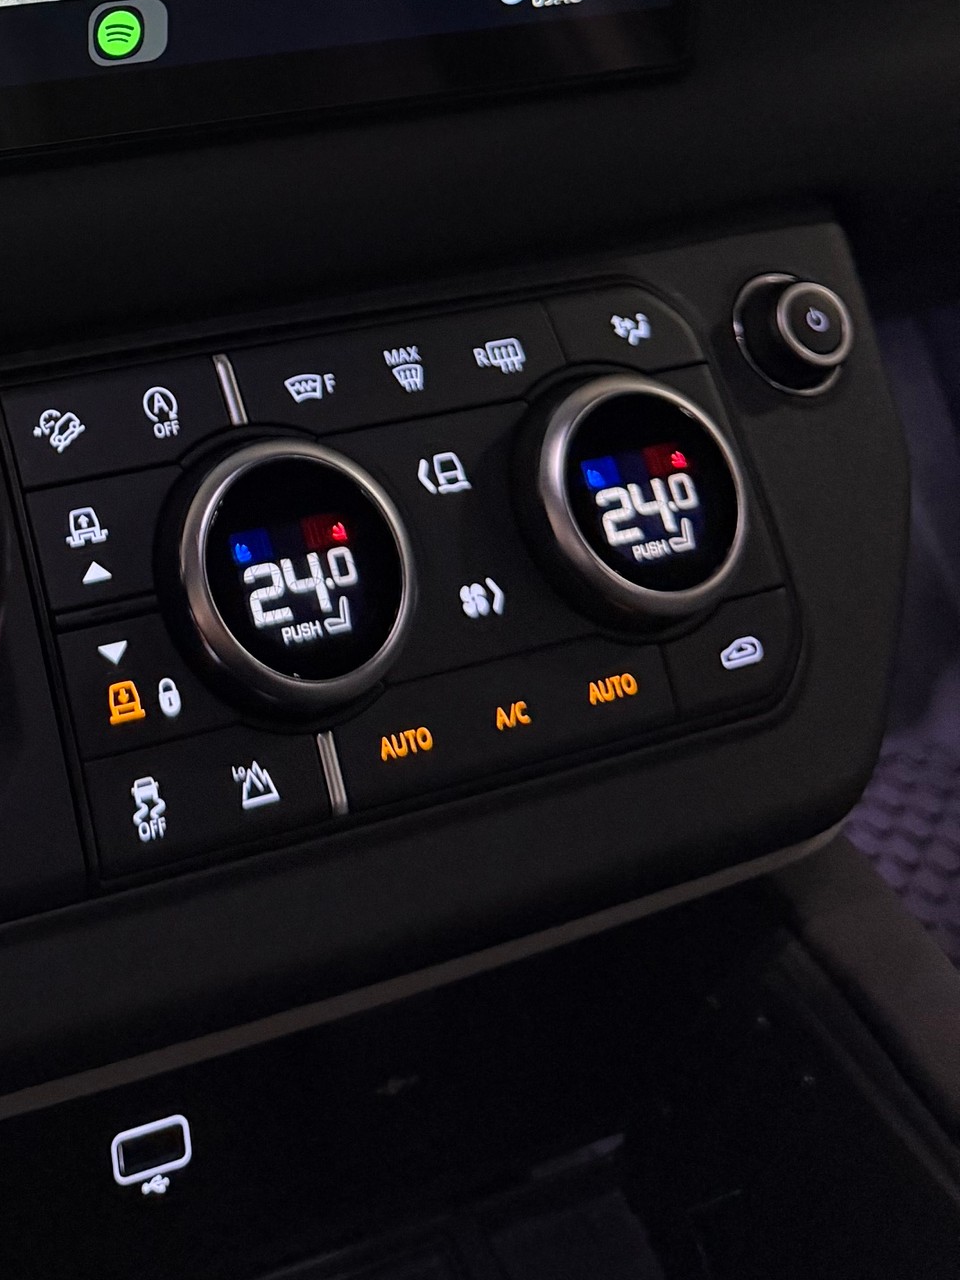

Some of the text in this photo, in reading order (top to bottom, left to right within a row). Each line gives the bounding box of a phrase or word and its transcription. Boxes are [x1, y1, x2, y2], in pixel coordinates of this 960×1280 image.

[383, 344, 422, 367] MAX
[473, 347, 488, 368] R
[323, 372, 337, 395] F
[153, 419, 181, 439] OFF
[632, 537, 669, 563] PUSH
[281, 620, 323, 647] PUSH
[588, 672, 639, 706] AUTO
[495, 700, 533, 731] A/C
[380, 725, 434, 761] AUTO
[138, 816, 167, 843] OFF
